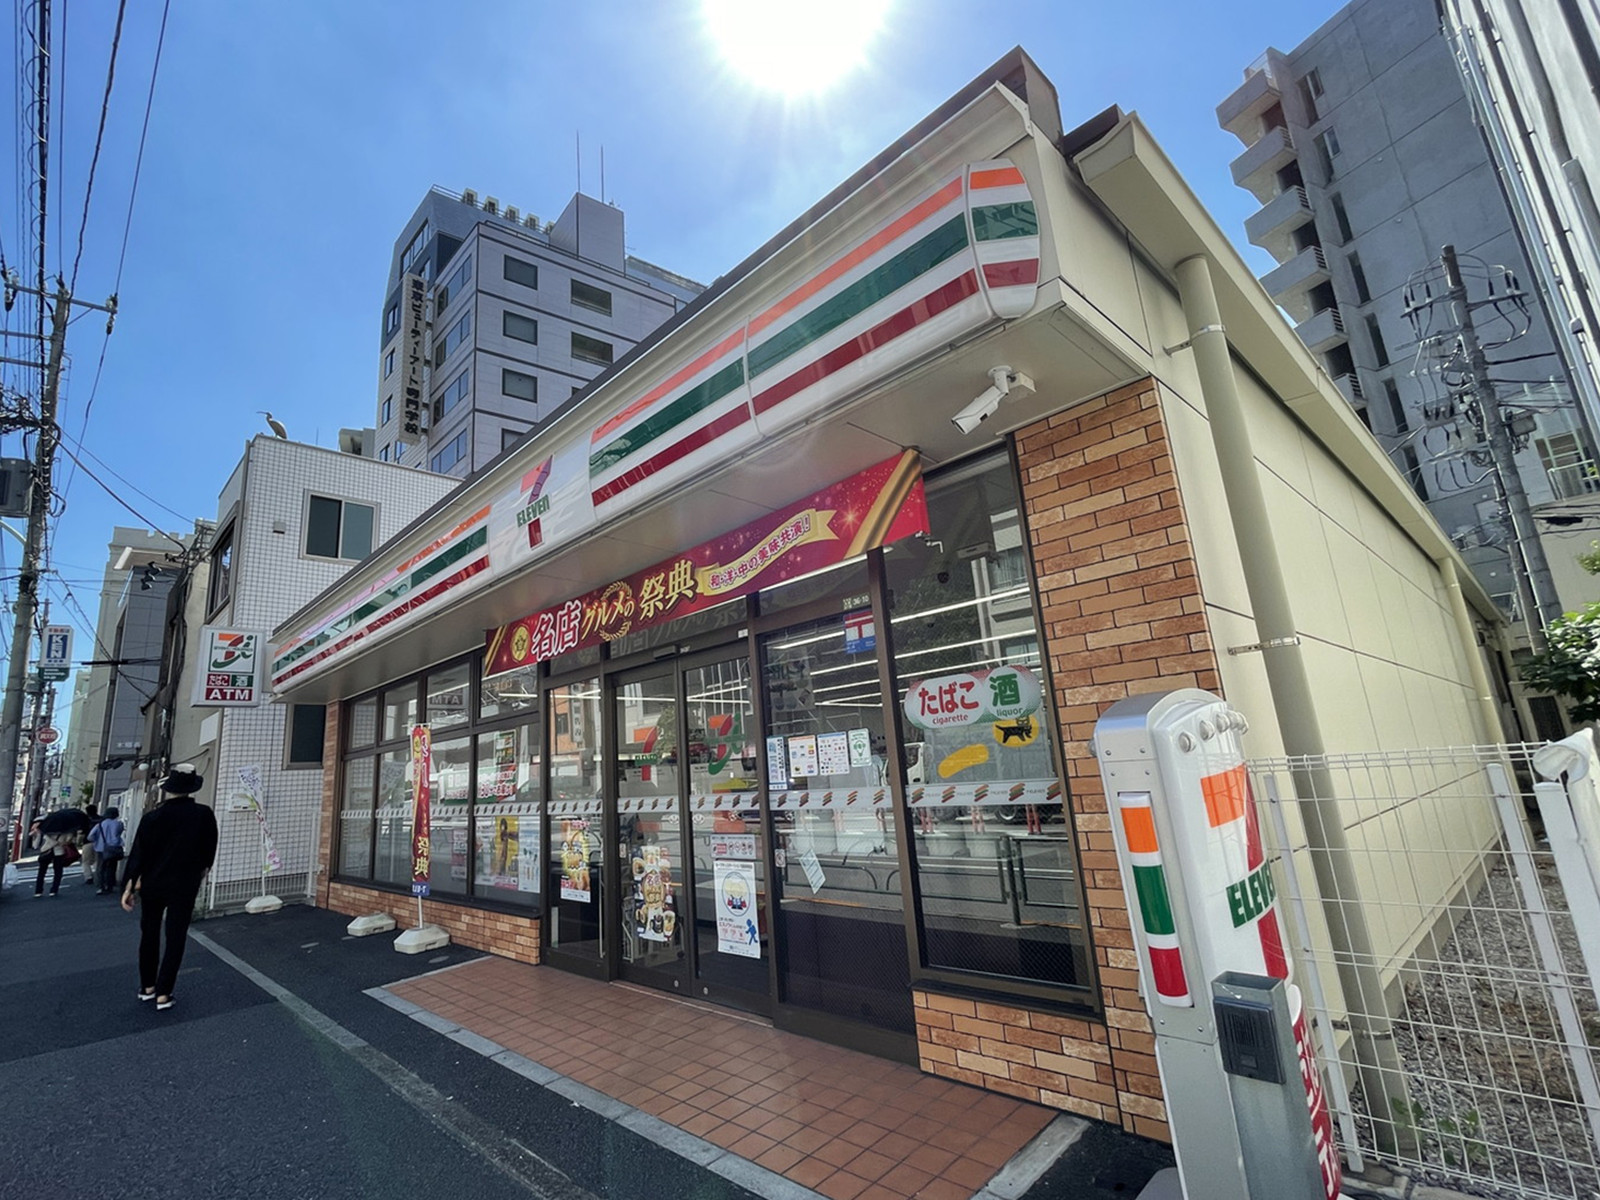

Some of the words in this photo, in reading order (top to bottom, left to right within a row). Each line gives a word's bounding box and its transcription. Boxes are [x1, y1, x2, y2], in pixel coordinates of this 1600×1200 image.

[235, 675, 249, 687] 酒
[209, 689, 249, 700] ATM
[918, 681, 980, 716] たばこ
[989, 673, 1021, 707] 酒
[996, 706, 1023, 718] liquor
[932, 713, 969, 726] cigarette
[1226, 858, 1276, 928] ELEVE
